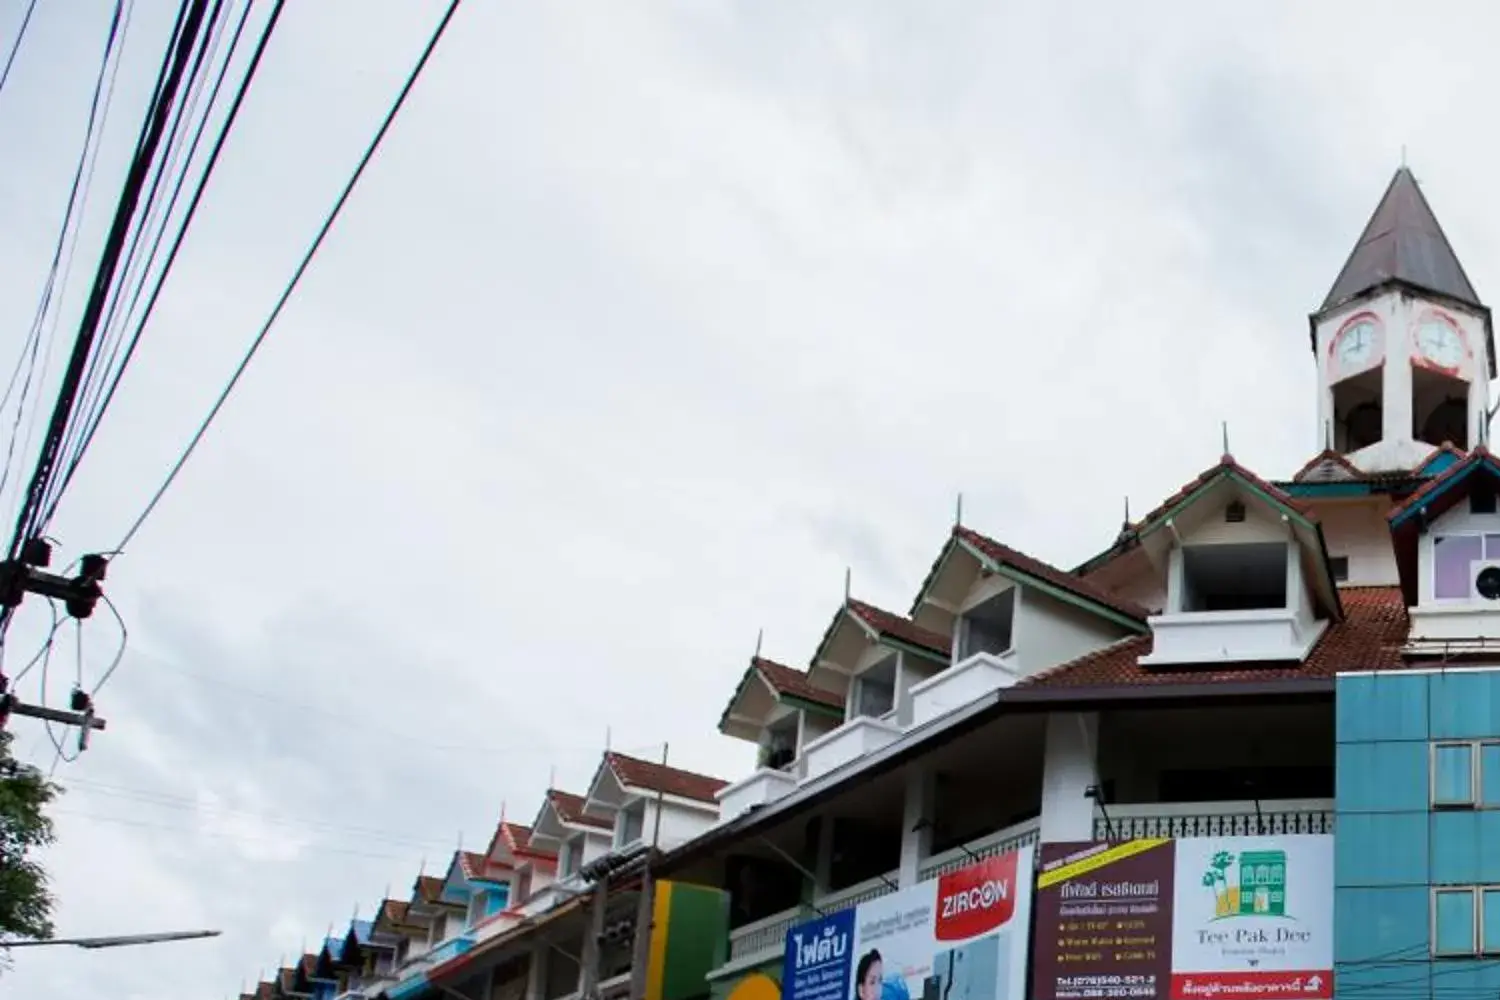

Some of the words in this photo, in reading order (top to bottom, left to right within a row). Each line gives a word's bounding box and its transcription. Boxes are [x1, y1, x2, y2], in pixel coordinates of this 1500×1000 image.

[942, 879, 1009, 919] ZIRCON
[794, 925, 848, 970] ไฟดับ
[1197, 929, 1229, 945] Tee
[1236, 928, 1269, 944] Pak
[1276, 927, 1311, 944] Dee
